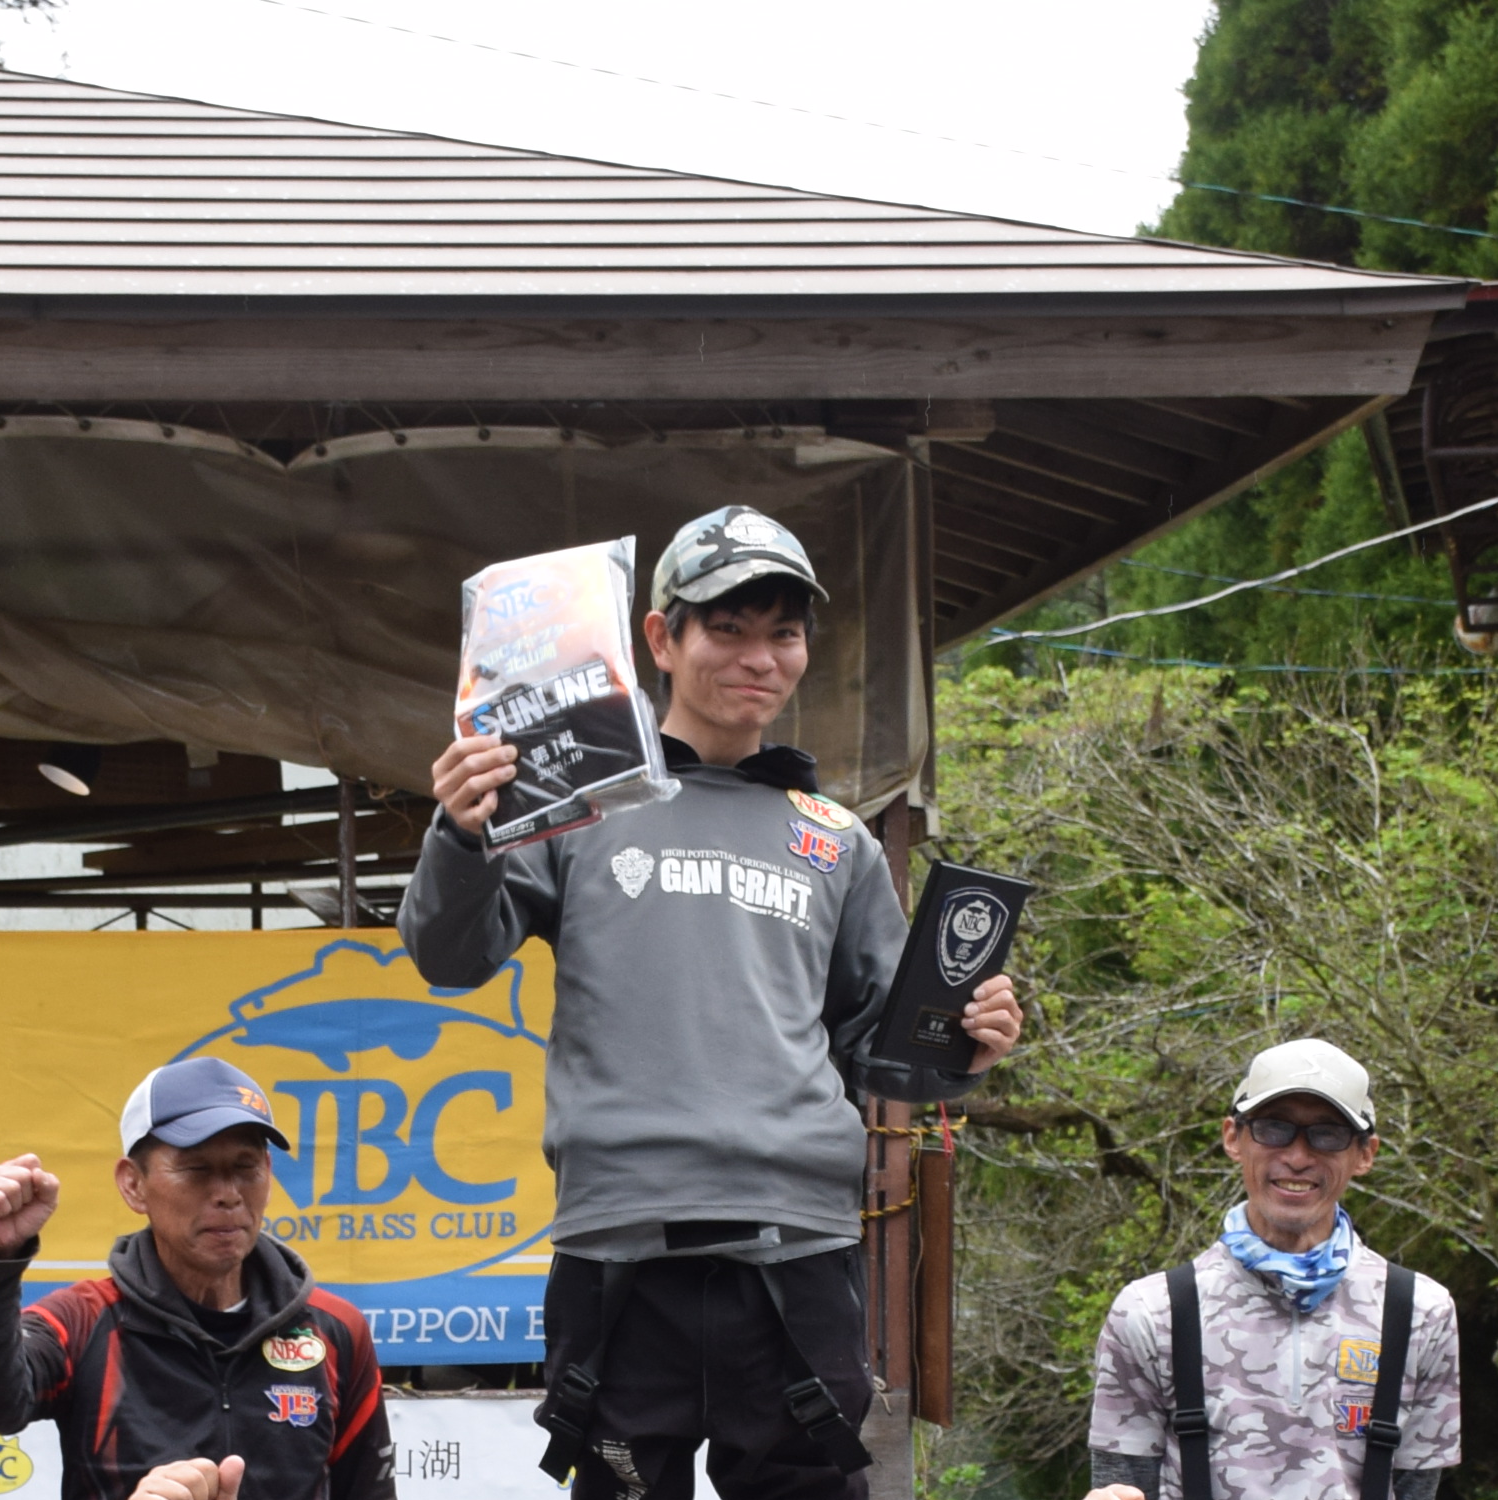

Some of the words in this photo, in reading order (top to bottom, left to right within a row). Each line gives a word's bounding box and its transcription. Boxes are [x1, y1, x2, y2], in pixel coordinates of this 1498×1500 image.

[472, 664, 611, 738] SUNLINE
[789, 831, 839, 863] JB
[661, 849, 679, 858] HIGH
[680, 850, 738, 863] POTENTIAL
[739, 856, 783, 876] ORIGINAL
[660, 858, 722, 895] GAN
[728, 863, 813, 921] CRAFT
[958, 913, 986, 933] NBC
[337, 1213, 417, 1241] BASS
[430, 1211, 517, 1239] CLUB
[362, 1306, 510, 1344] IPPON
[270, 1339, 315, 1361] NBC
[1345, 1346, 1379, 1372] NB
[268, 1394, 318, 1423] JB
